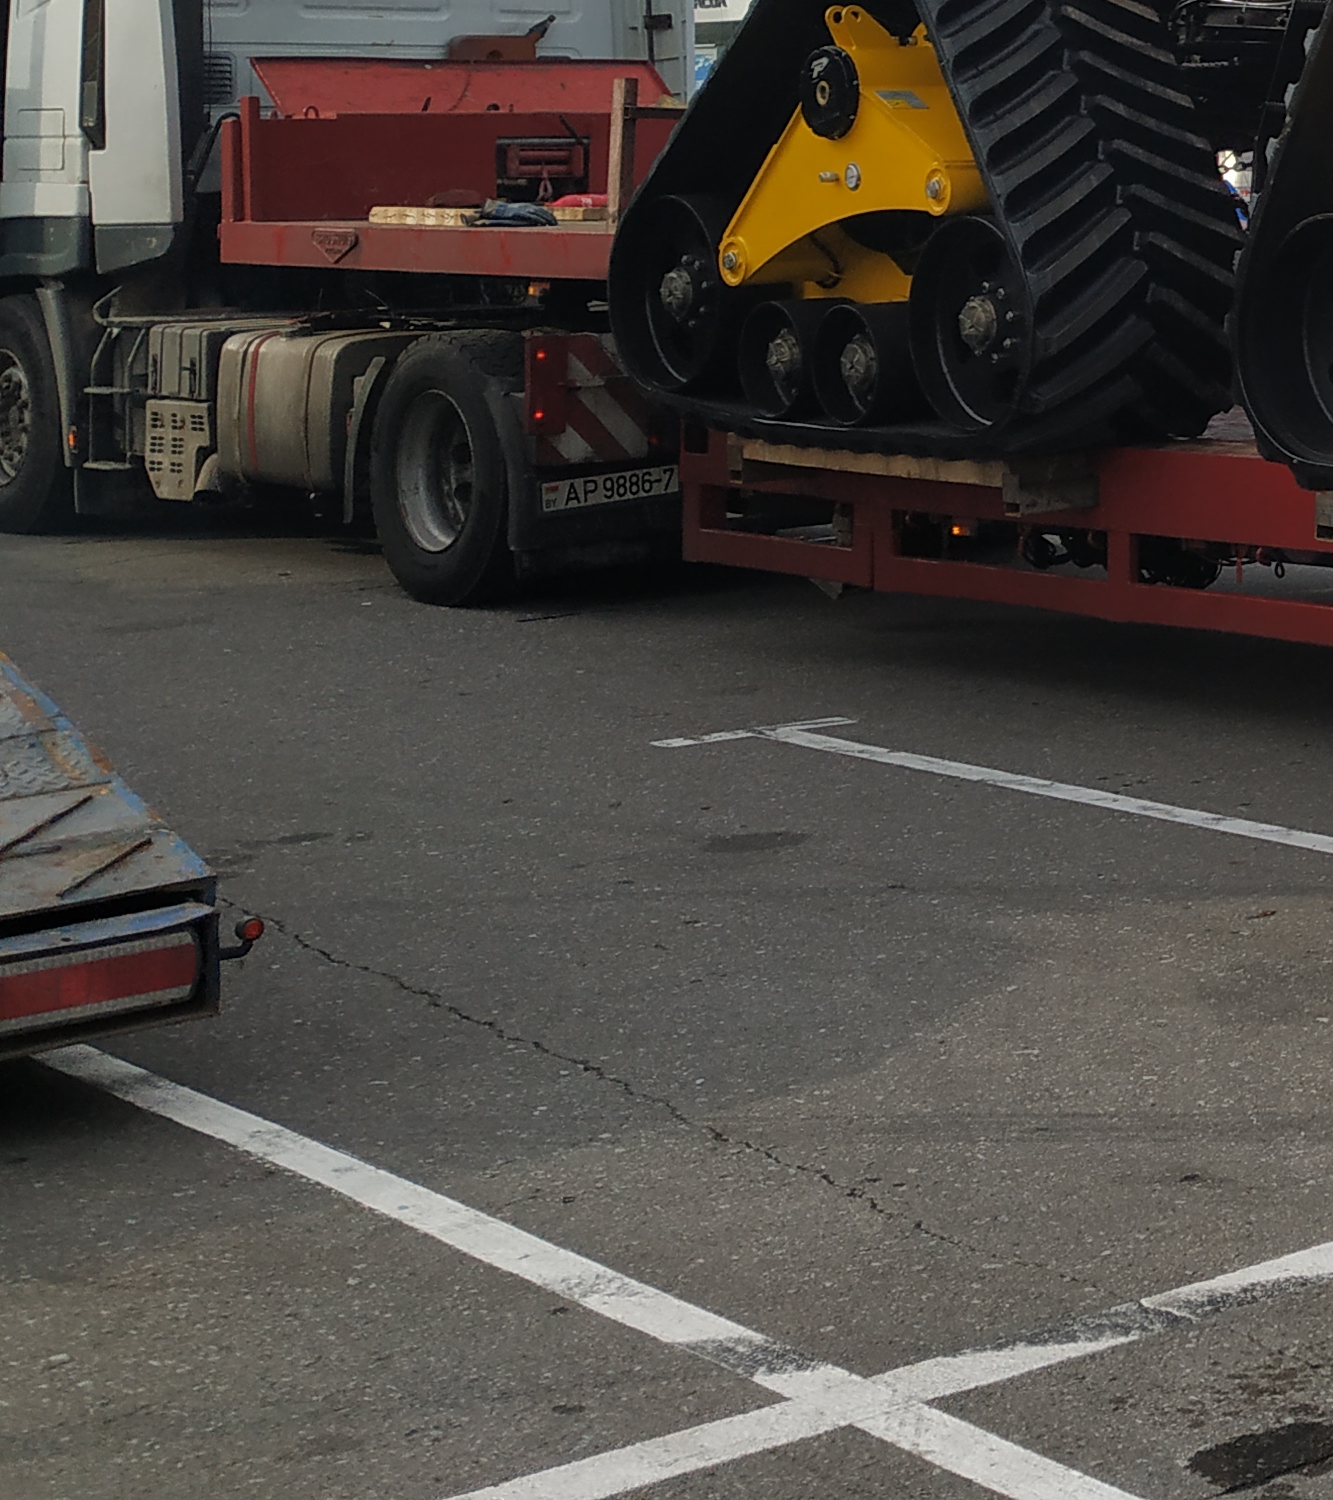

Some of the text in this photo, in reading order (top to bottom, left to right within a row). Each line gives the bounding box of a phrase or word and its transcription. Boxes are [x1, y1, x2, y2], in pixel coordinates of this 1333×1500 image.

[565, 468, 675, 506] AP 9886-7
[545, 498, 557, 509] BY
